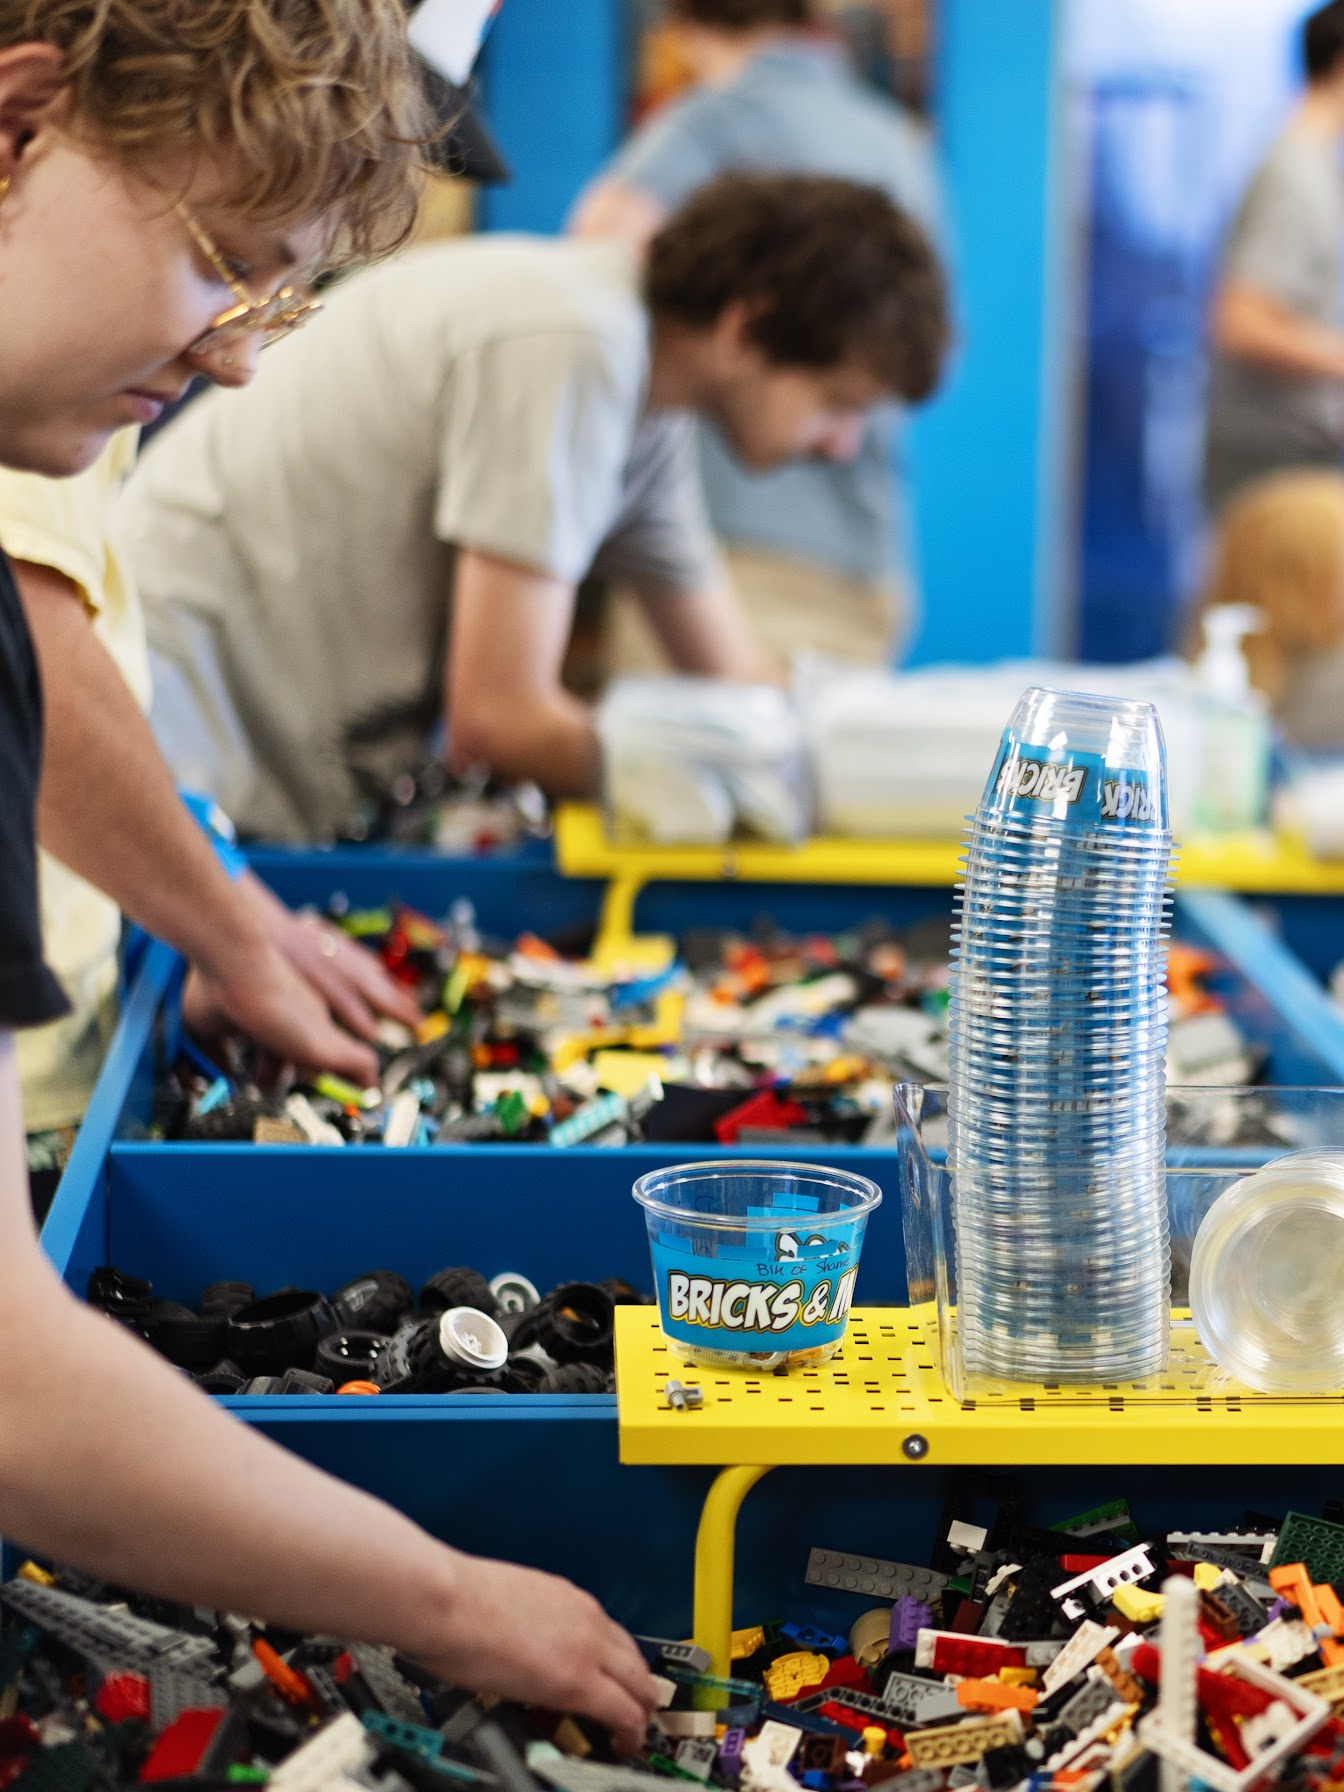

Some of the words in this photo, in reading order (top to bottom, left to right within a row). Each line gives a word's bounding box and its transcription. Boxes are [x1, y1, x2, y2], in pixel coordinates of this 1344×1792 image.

[668, 1269, 804, 1333] BRICKS
[801, 1278, 832, 1327] &
[826, 1263, 859, 1324] M
